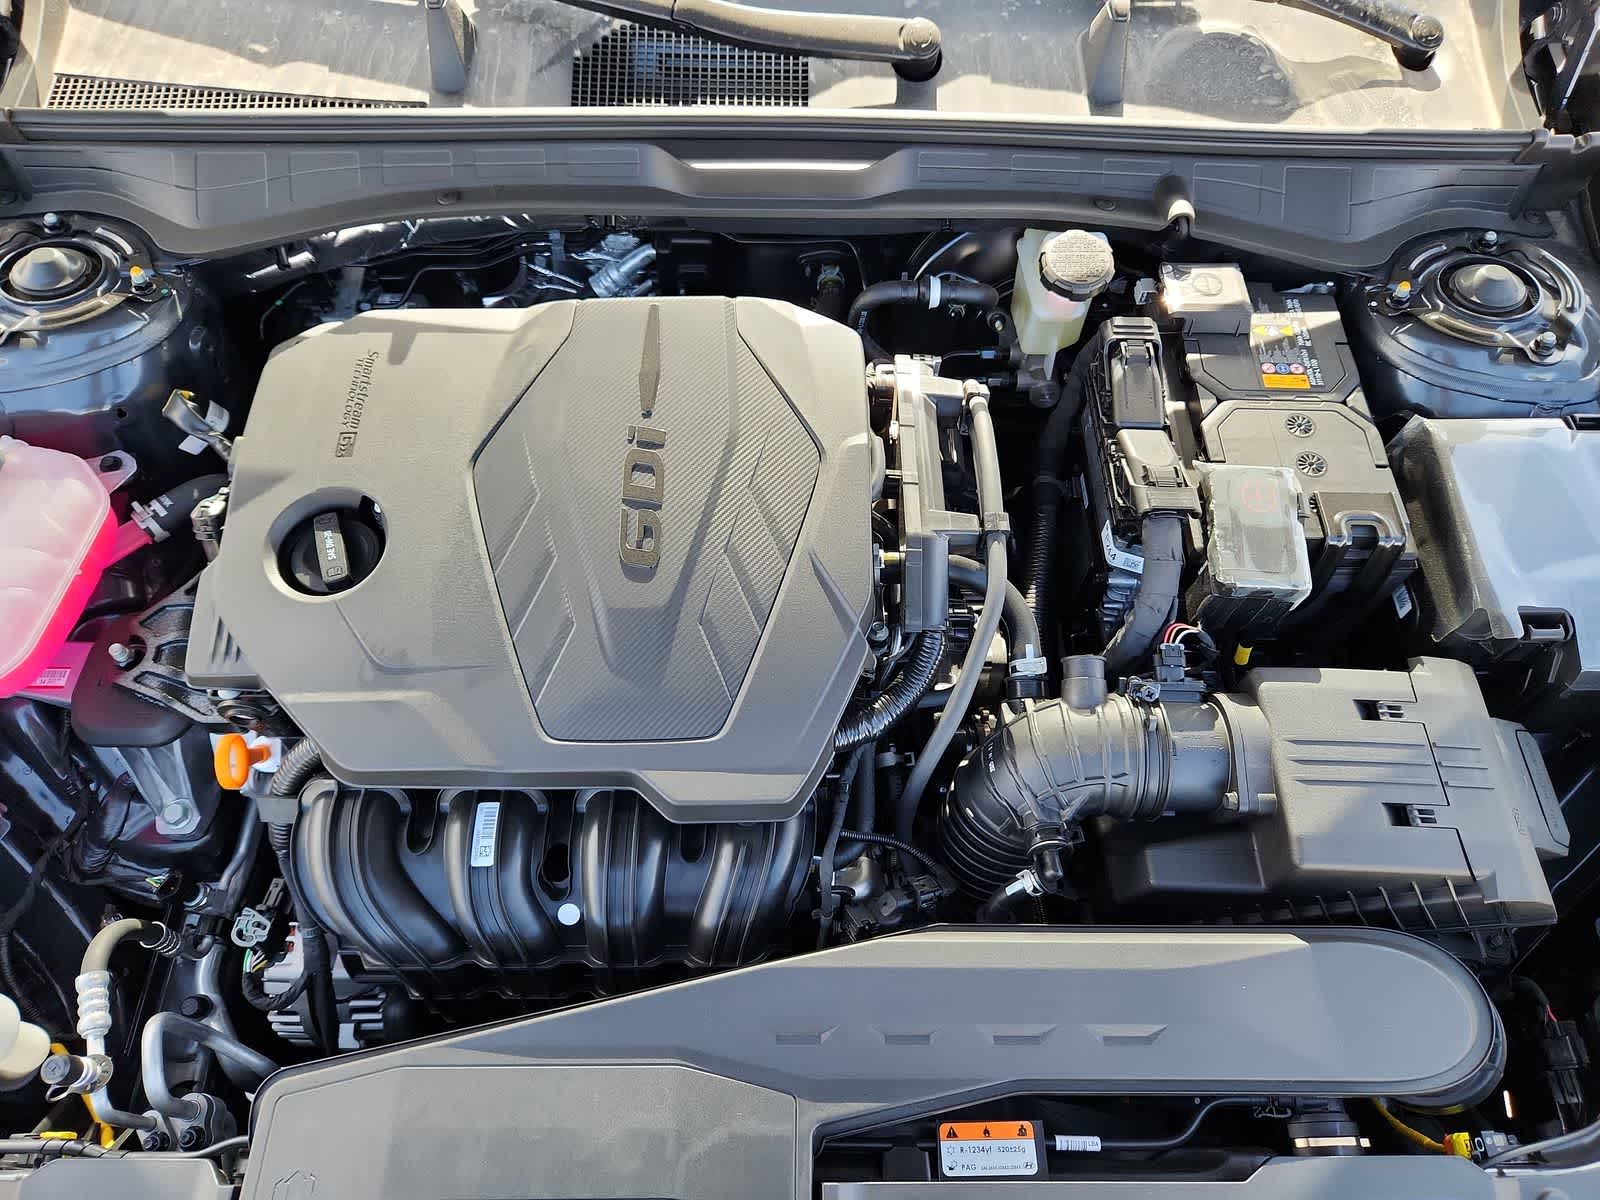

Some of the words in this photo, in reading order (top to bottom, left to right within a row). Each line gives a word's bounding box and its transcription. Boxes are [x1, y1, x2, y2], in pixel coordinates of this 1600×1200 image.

[341, 357, 365, 429] TECHNOLOGY
[351, 350, 379, 429] Smartstream
[618, 424, 668, 576] GDi
[959, 1145, 992, 1155] R-1234yf
[961, 1163, 977, 1171] PAG
